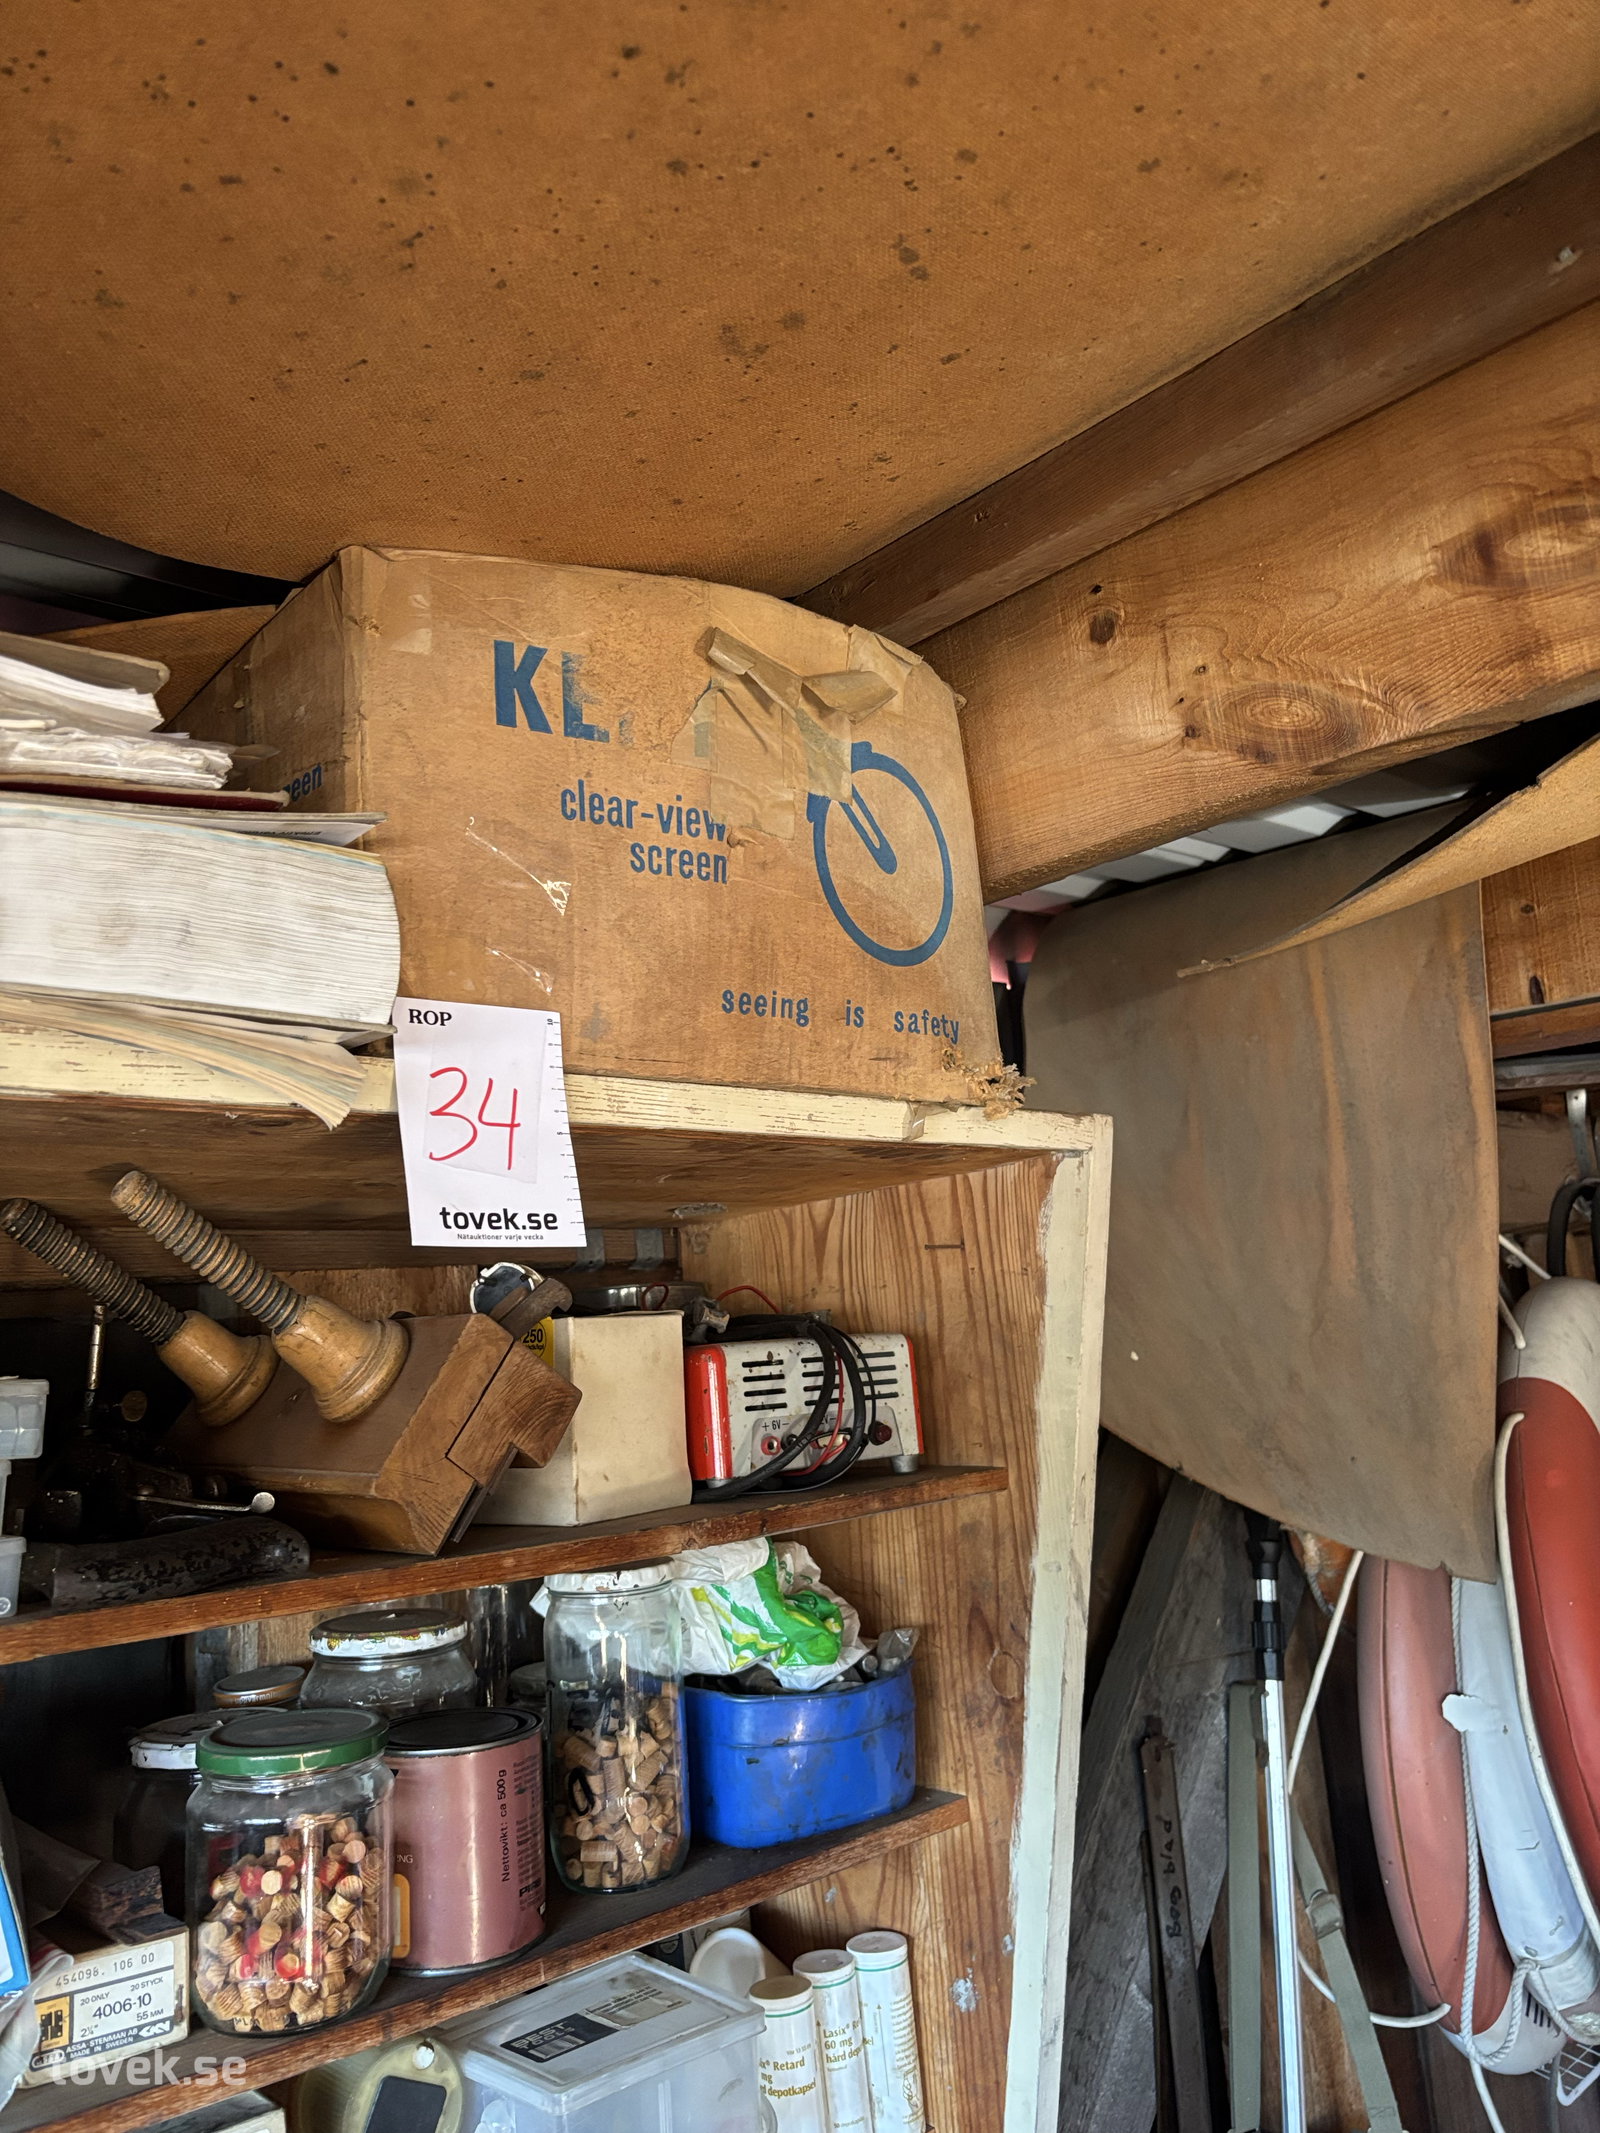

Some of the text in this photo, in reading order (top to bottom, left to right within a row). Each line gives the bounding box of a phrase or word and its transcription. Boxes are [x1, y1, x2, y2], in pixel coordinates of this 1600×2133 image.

[560, 779, 727, 842] clear-view
[629, 842, 728, 885] screen
[408, 1008, 453, 1027] ROP
[721, 989, 960, 1045] seeing is safety
[429, 1066, 522, 1171] 34
[439, 1206, 559, 1231] tovek.se
[504, 1234, 522, 1242] varje
[524, 1233, 544, 1241] vecka
[522, 1328, 544, 1344] 250
[113, 1958, 134, 1973] 106
[141, 1952, 156, 1966] 00
[130, 1976, 164, 1992] 20 STYCK
[91, 1991, 111, 2003] ONLY
[92, 1992, 152, 2019] 4006-10
[136, 2008, 164, 2022] 55 MM
[70, 2048, 90, 2059] MADE
[93, 2045, 102, 2053] IN
[105, 2036, 134, 2050] SWEDEN
[824, 2039, 837, 2050] 60
[839, 2036, 854, 2048] mg
[772, 2055, 806, 2071] Retard
